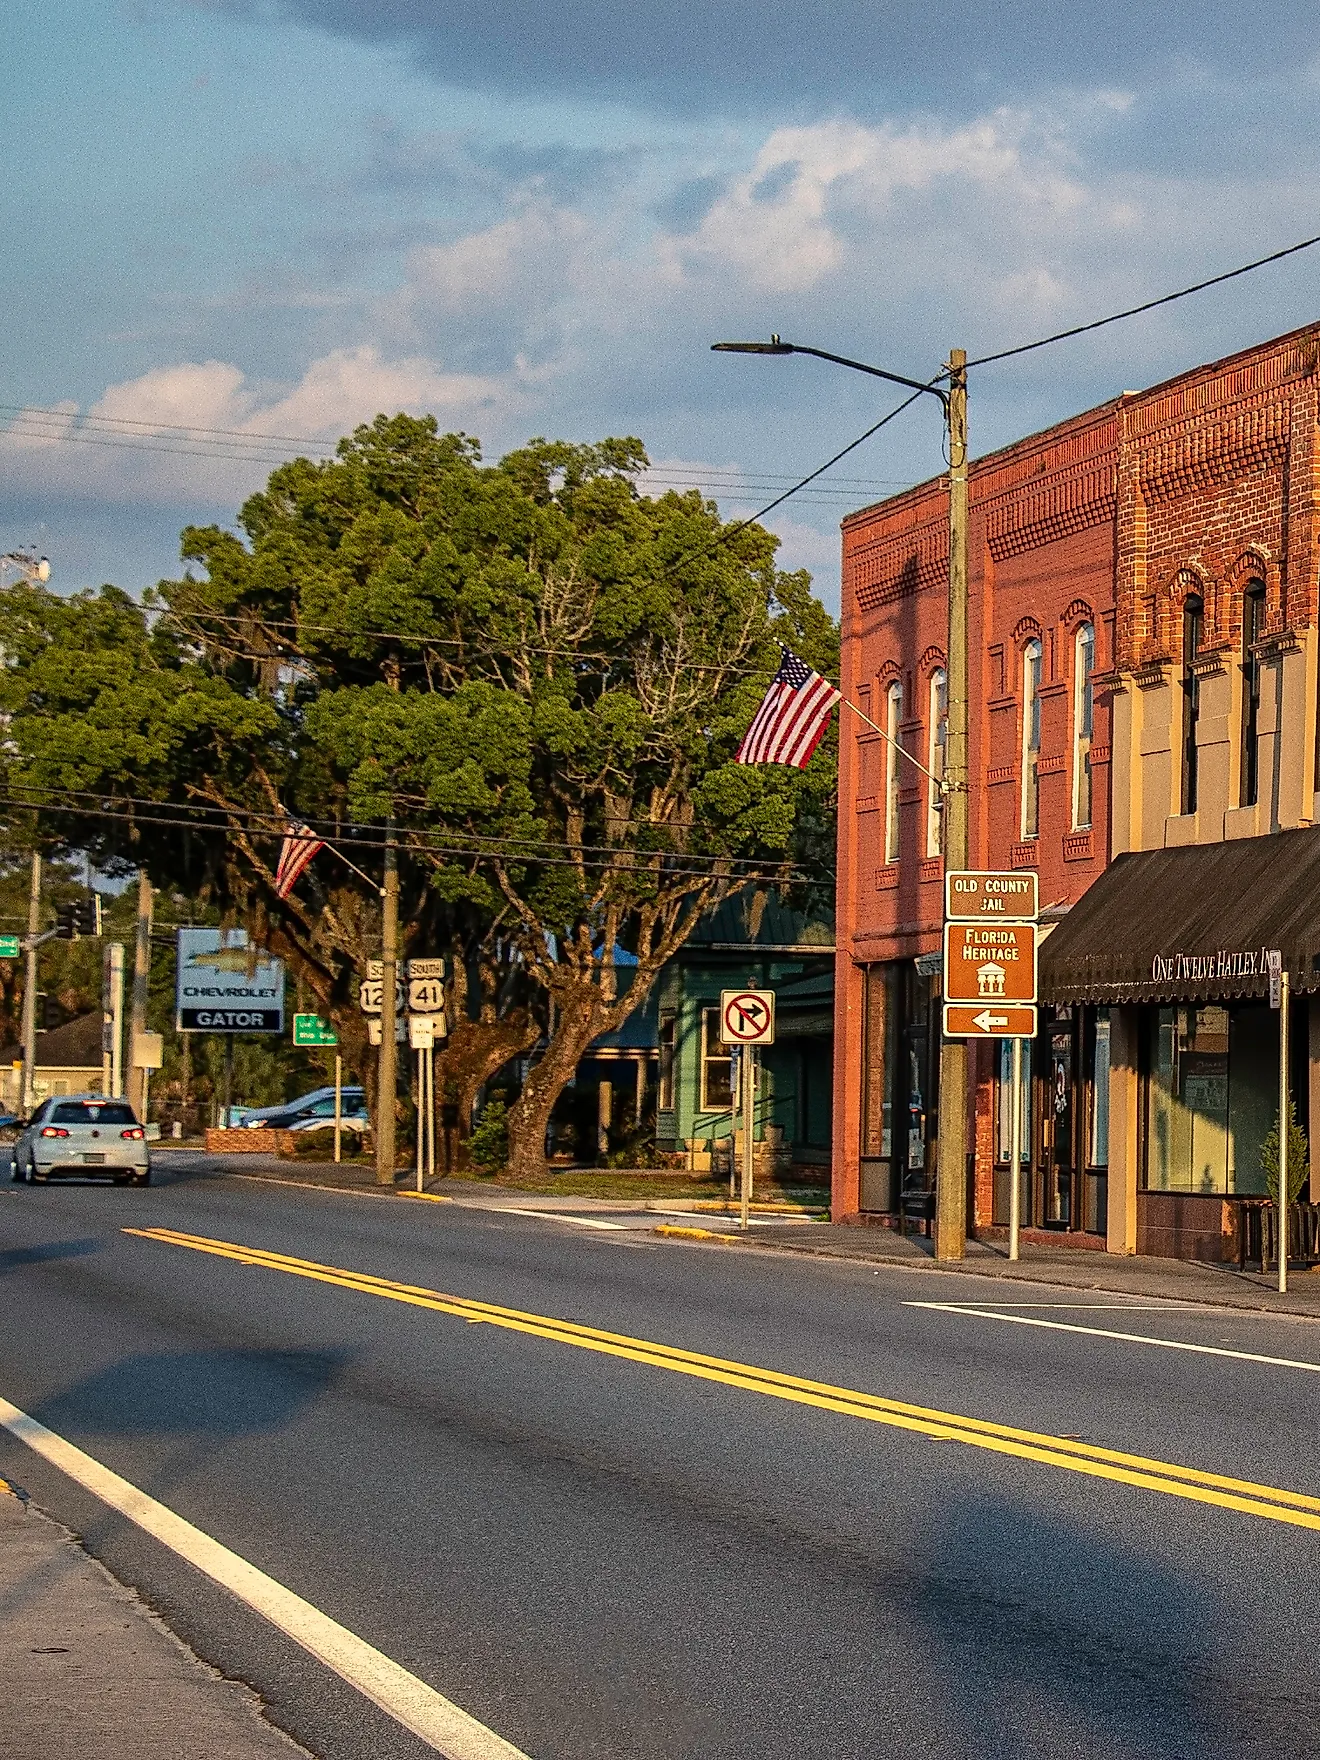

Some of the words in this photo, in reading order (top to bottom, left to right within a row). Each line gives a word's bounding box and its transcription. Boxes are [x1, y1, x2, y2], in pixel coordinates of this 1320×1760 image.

[954, 879, 978, 893] OLD
[985, 879, 1029, 893] COUNTY
[980, 898, 1006, 911] JAIL
[965, 928, 1017, 944] FLORIDA
[962, 945, 1020, 961] HERITAGE
[410, 963, 440, 975] SOUTH
[1152, 954, 1174, 981] ONE
[1176, 953, 1215, 980] TWELVE
[183, 987, 277, 998] CHEVROLET
[364, 987, 397, 1006] 12
[415, 986, 437, 1004] 41
[196, 1012, 264, 1026] GATOR
